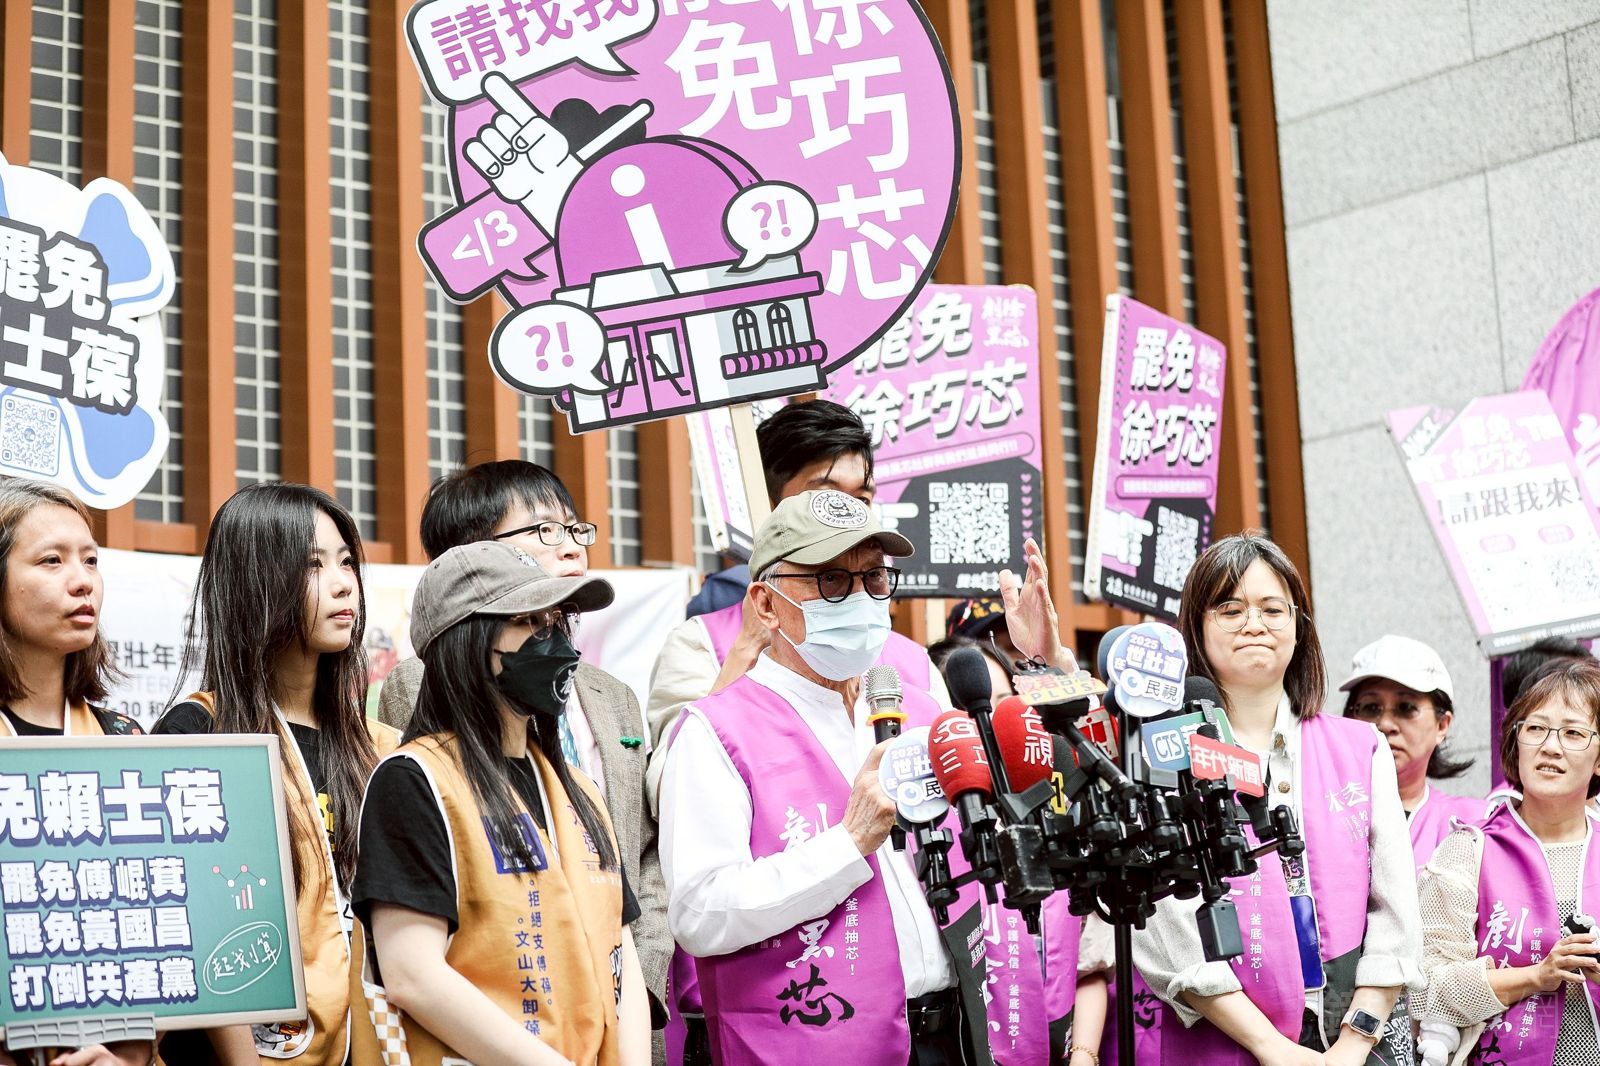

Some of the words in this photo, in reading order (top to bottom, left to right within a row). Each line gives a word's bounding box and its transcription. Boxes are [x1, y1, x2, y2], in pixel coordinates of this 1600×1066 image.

[662, 0, 793, 137] 免
[1130, 326, 1196, 393] 罷免
[1119, 399, 1218, 467] 徐巧芯
[1145, 680, 1179, 702] 民視
[5, 905, 192, 955] 罷免黃國昌
[212, 932, 278, 980] 超划算
[10, 957, 197, 1007] 打倒共產黨
